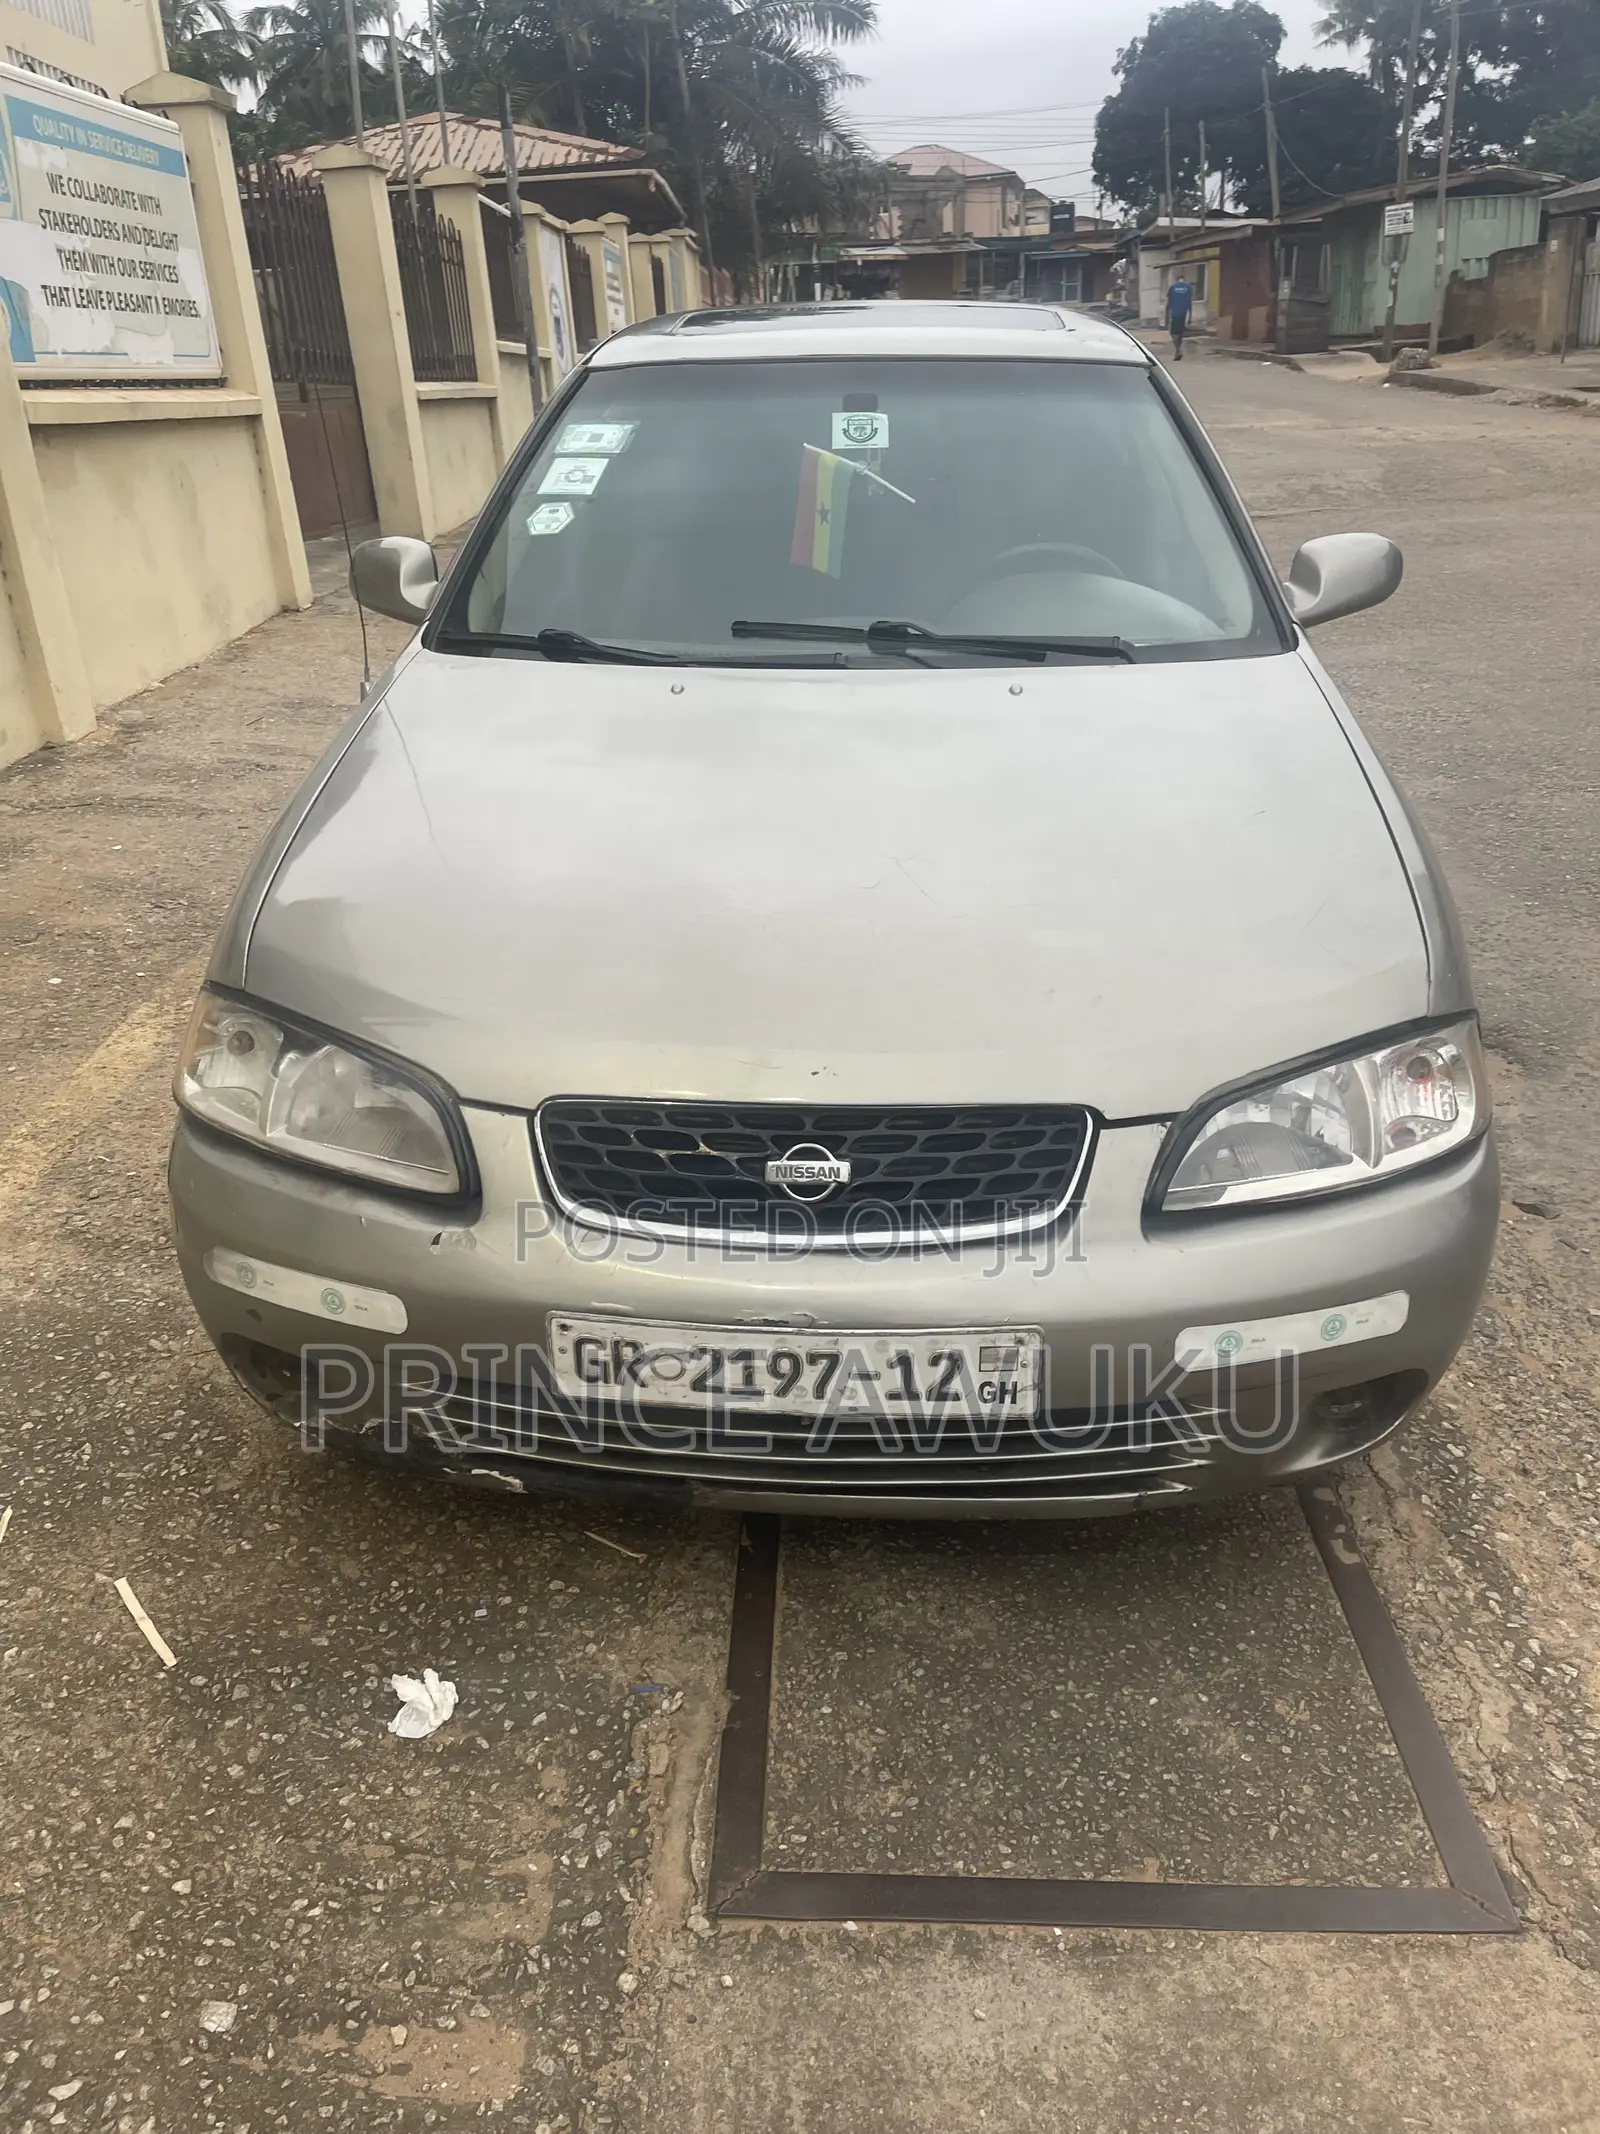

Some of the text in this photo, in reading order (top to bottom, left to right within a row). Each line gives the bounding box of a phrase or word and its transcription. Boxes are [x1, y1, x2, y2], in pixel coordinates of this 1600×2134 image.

[33, 114, 75, 143] QUALITY
[75, 126, 88, 147] IN
[88, 130, 123, 156] SERVICE
[46, 172, 163, 217] WE COLLABORATE WITH
[39, 208, 179, 253] STAKEHOLDERS AND DELIGHT
[56, 247, 179, 284] THEM WITH OUR SERVICES
[41, 284, 71, 308] THAT
[72, 287, 106, 311] LEAVE
[106, 291, 153, 315] PLEASANT
[774, 1164, 842, 1180] NISSAN
[573, 1334, 648, 1388] GR
[978, 1380, 1019, 1405] GH
